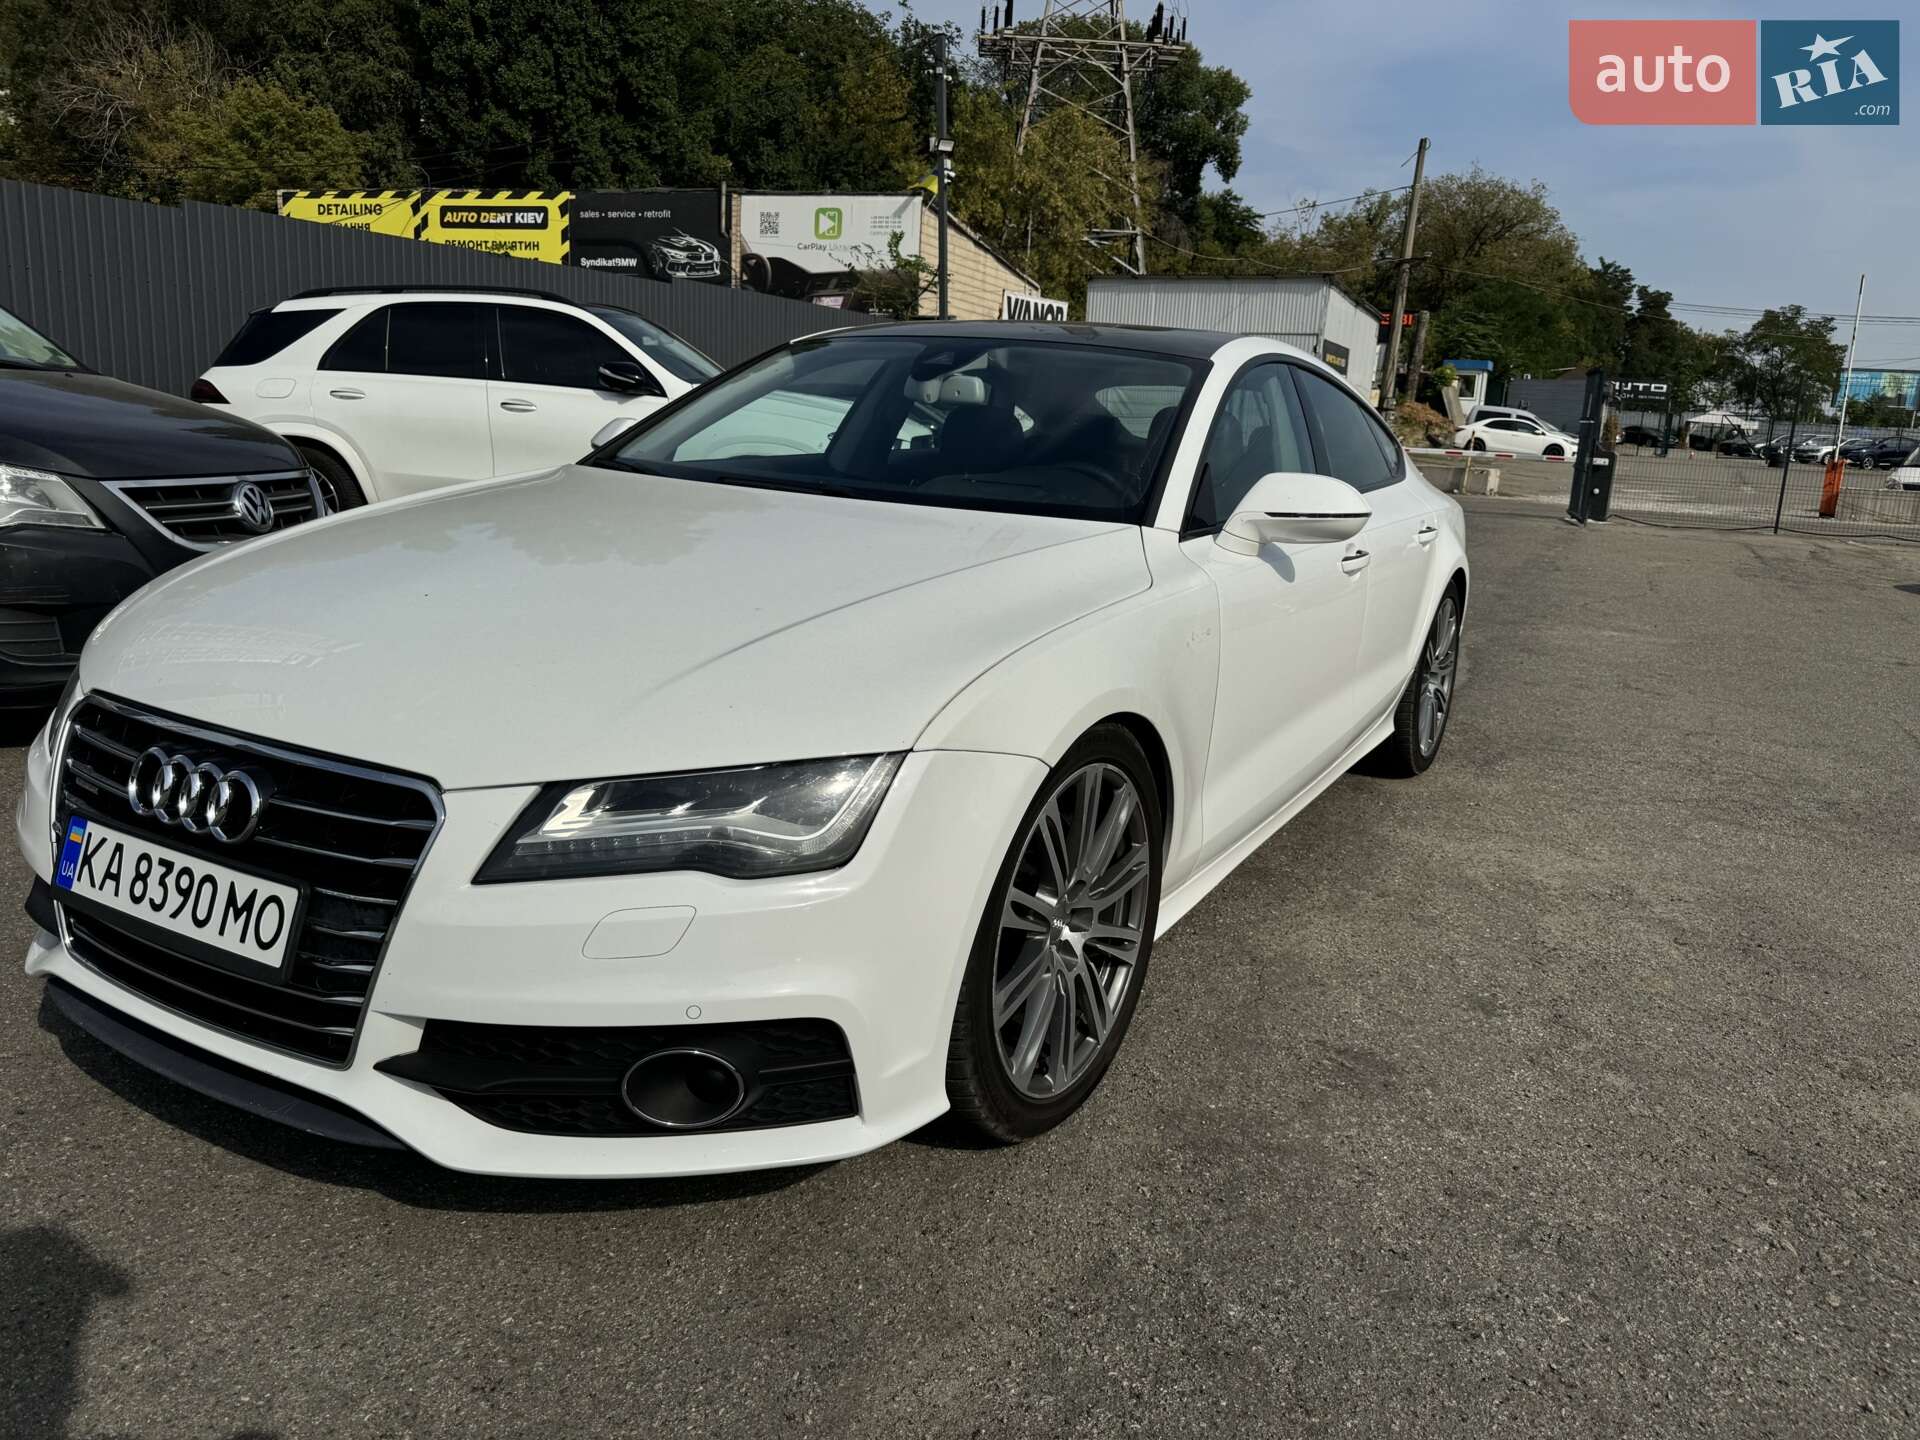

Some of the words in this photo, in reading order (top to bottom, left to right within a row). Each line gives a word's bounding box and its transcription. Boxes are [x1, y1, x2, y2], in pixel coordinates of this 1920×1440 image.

[318, 203, 383, 216] DETAILING
[579, 209, 600, 218] sales
[607, 209, 636, 218] service
[643, 209, 671, 218] retrofit
[443, 211, 478, 223] AUTO
[479, 212, 513, 224] DENT
[515, 212, 544, 224] KIEV
[797, 242, 827, 252] CarPlay
[580, 257, 638, 268] SyndikatBMW
[61, 860, 74, 877] UA
